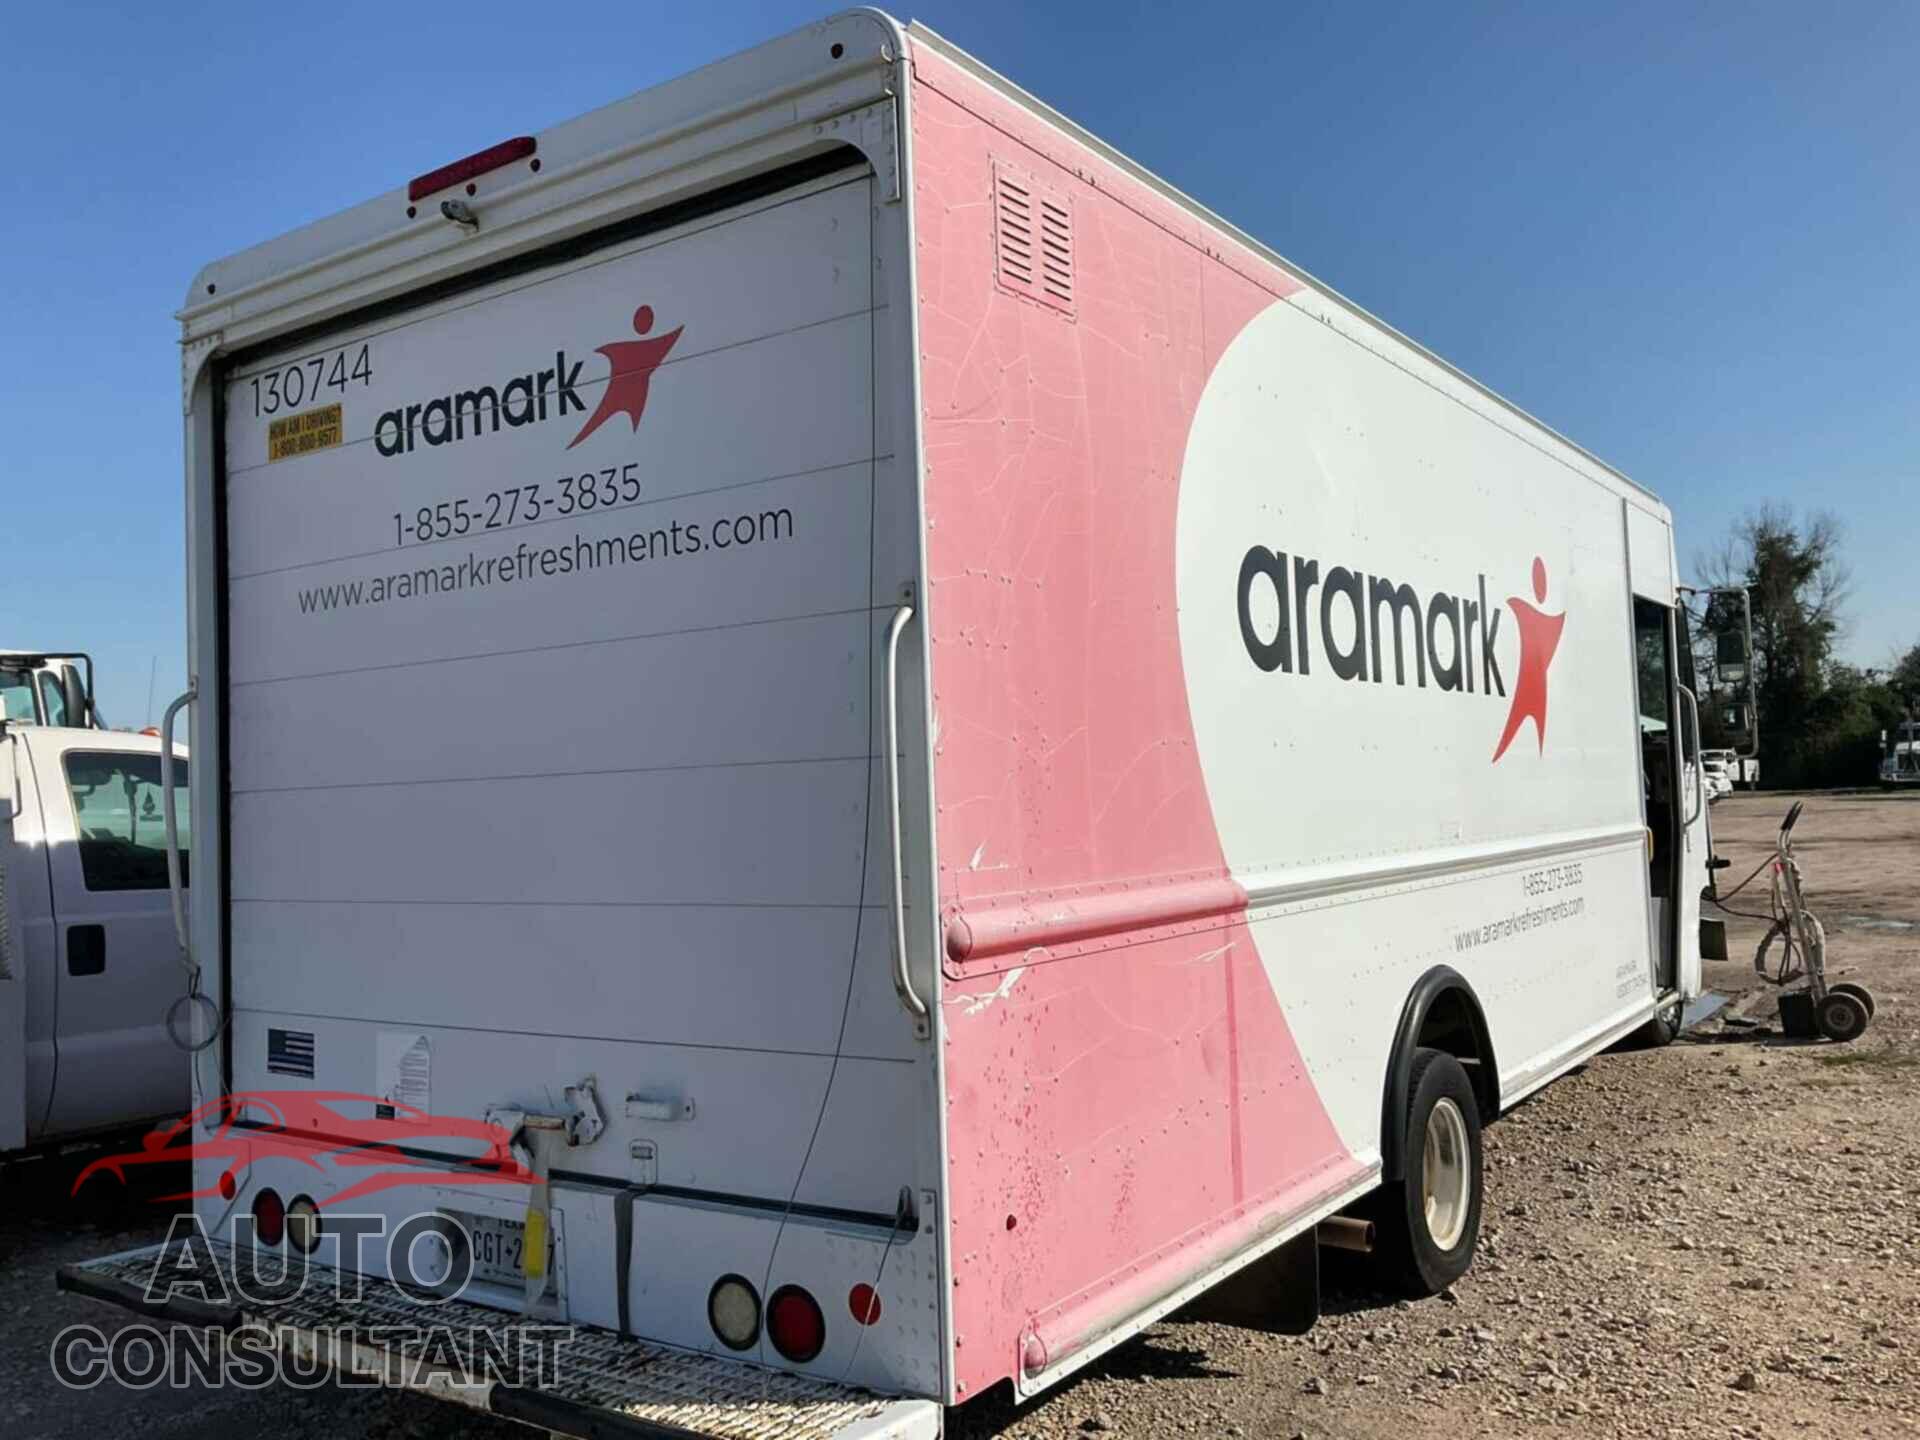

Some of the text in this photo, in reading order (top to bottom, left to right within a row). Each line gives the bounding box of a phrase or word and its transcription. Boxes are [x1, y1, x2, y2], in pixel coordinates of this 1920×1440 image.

[251, 344, 373, 417] 130744
[374, 351, 587, 457] aramark
[394, 463, 641, 546] 1-855-273-3835
[299, 508, 794, 614] www.aramarkrefreshments.com
[1237, 544, 1506, 697] aramark
